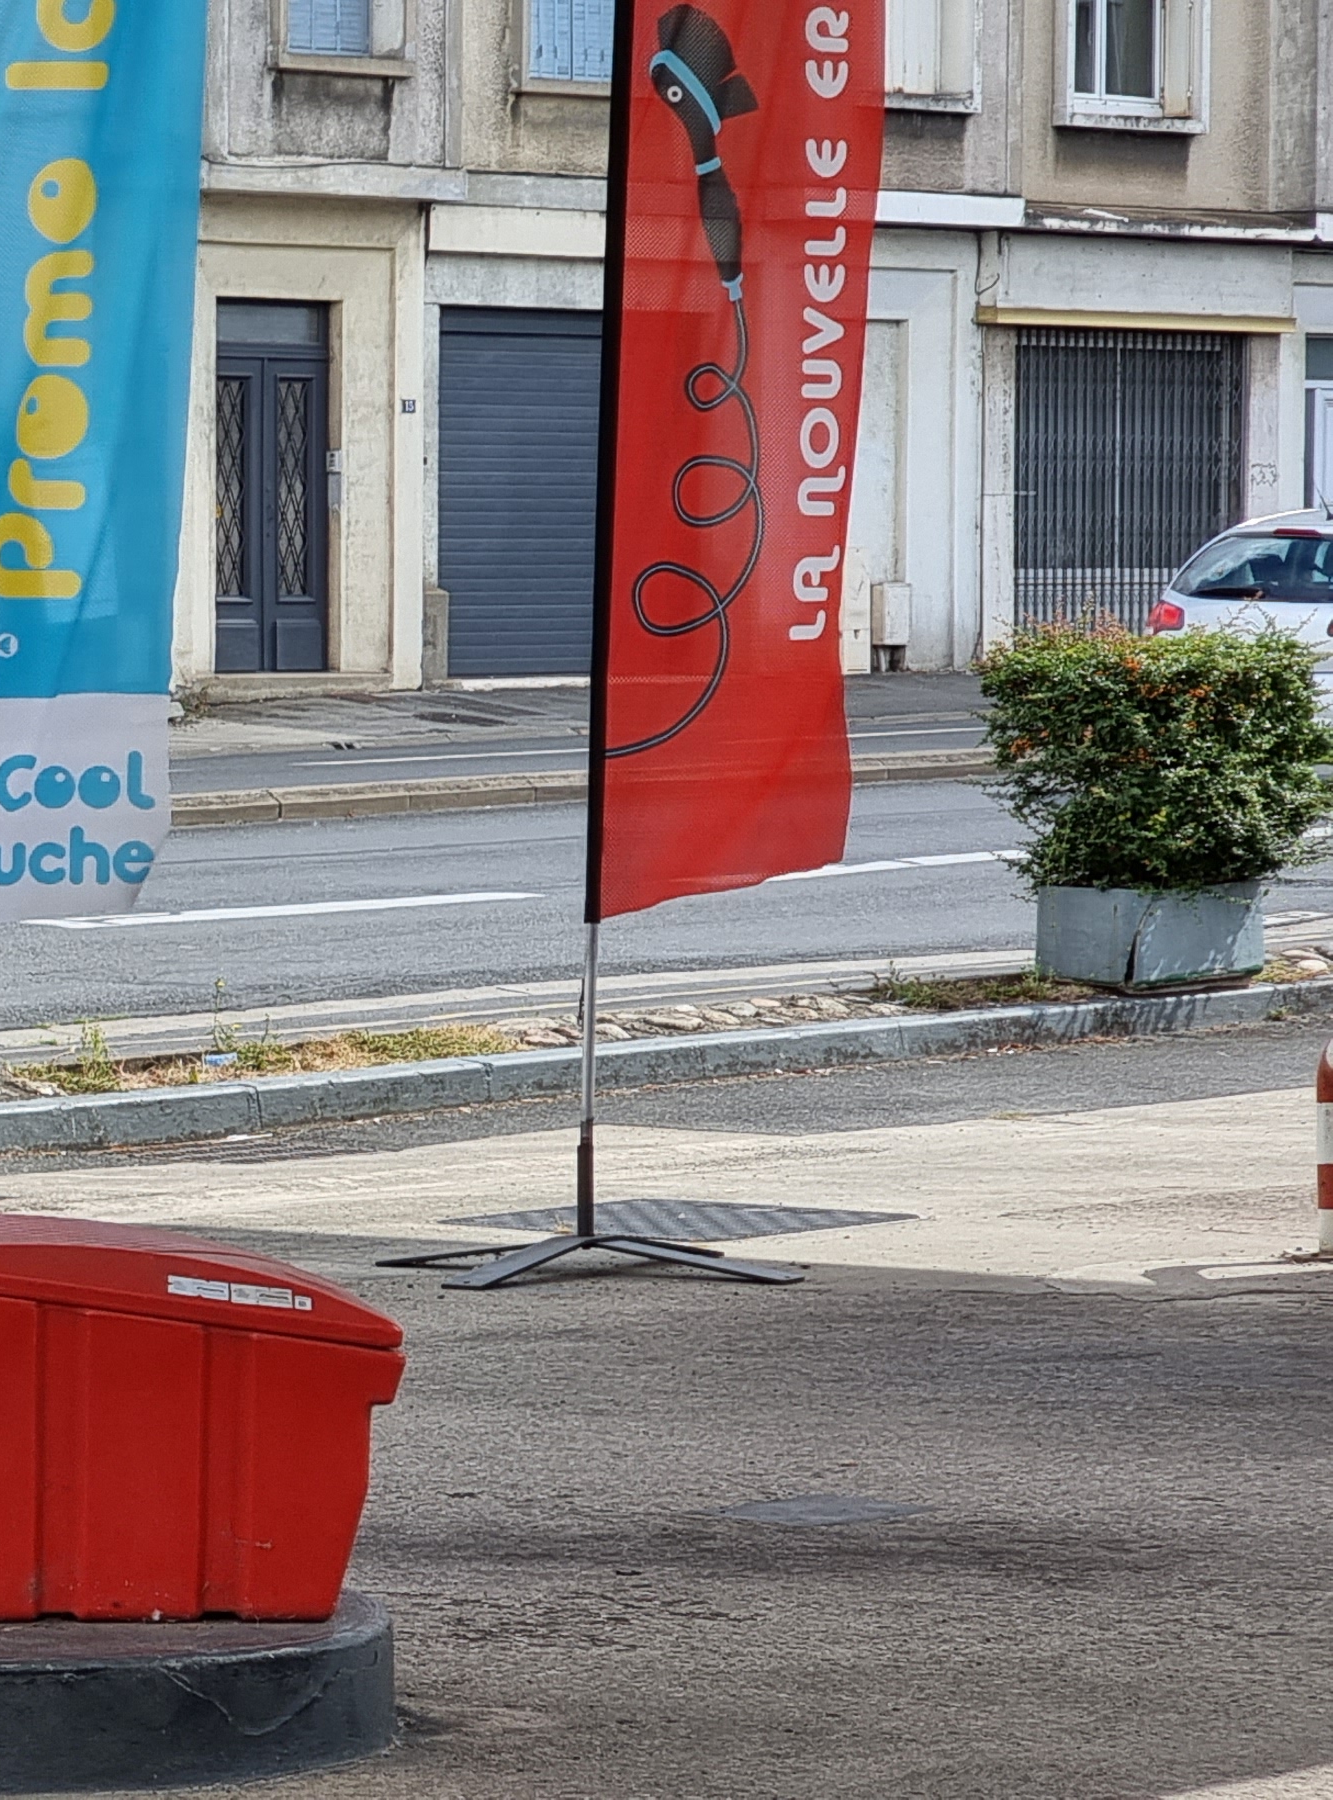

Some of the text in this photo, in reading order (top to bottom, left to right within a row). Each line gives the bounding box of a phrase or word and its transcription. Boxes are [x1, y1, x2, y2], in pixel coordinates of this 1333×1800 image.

[788, 4, 850, 641] LA NOUVELLE ER
